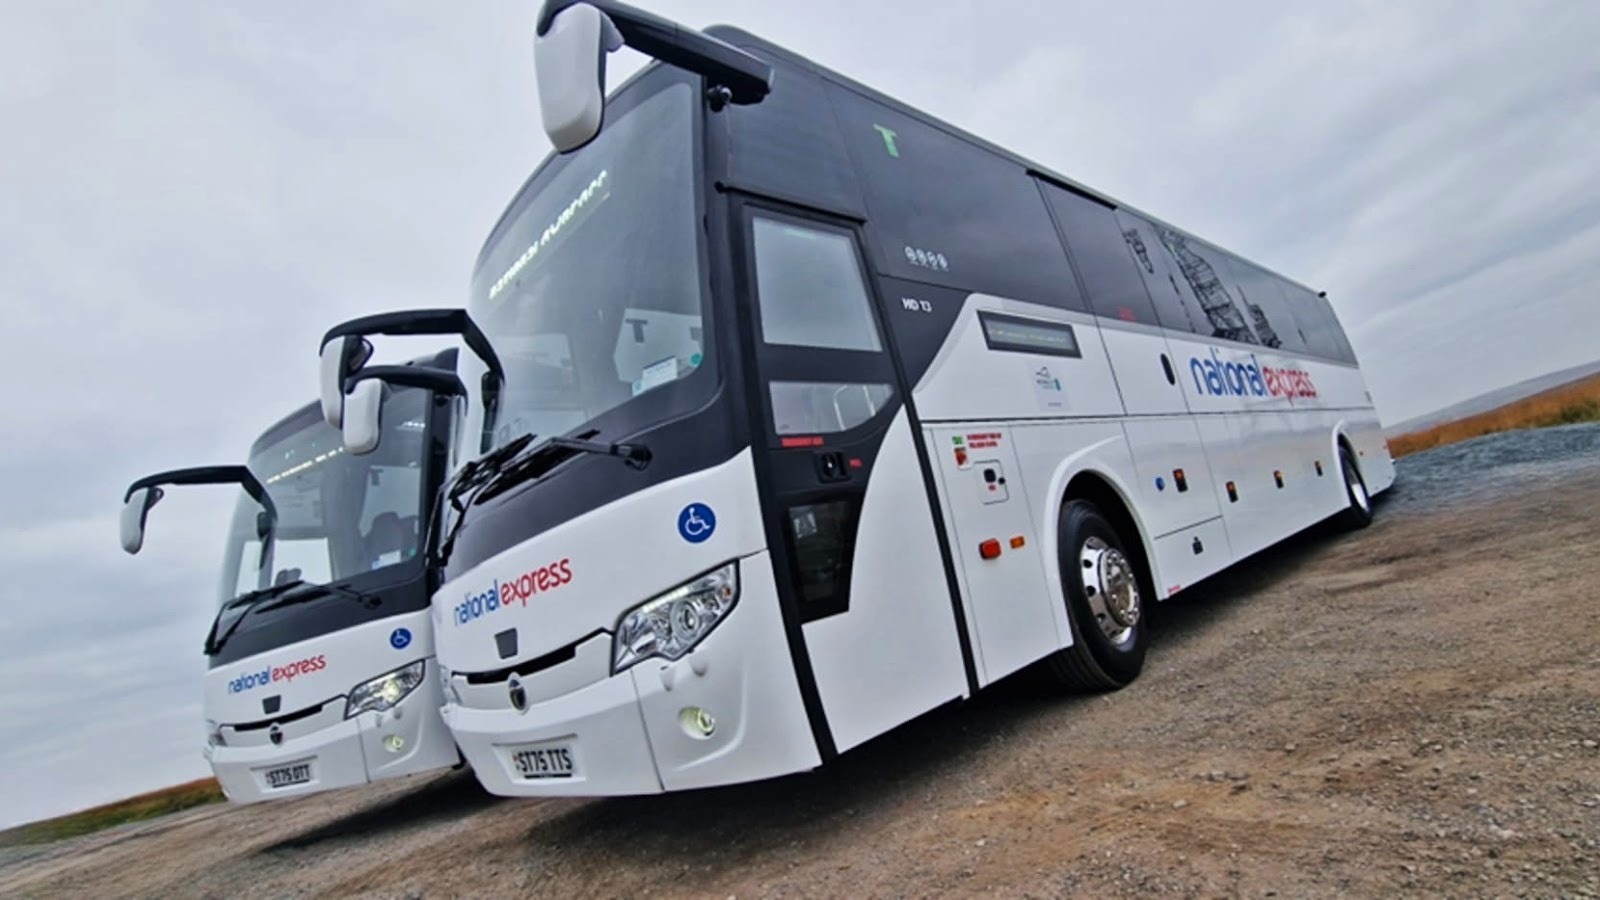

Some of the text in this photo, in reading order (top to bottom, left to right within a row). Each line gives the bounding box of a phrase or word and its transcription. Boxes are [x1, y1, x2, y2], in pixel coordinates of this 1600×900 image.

[1190, 346, 1317, 408] national express
[454, 558, 572, 627] national express
[229, 654, 327, 695] national express
[518, 748, 573, 772] ST75 TTS
